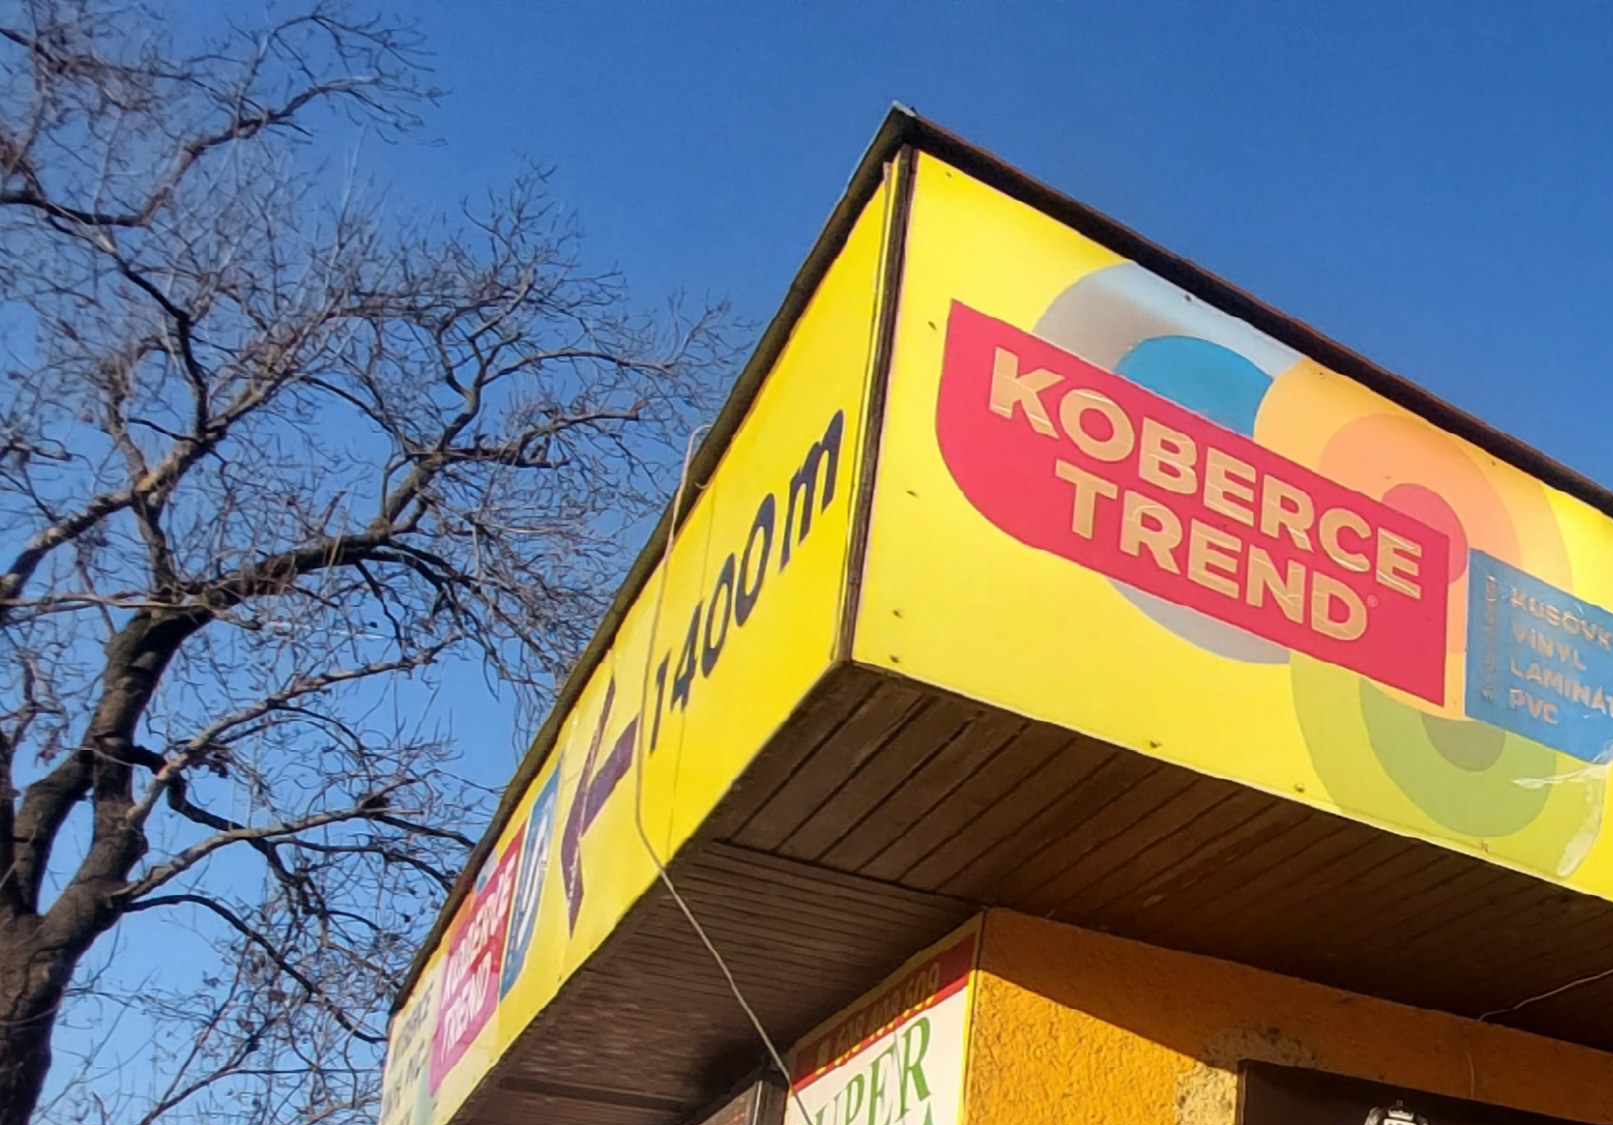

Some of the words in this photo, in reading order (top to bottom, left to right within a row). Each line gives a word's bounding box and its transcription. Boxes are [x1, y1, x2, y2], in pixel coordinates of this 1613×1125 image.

[988, 346, 1423, 600] KOBERCE
[1054, 460, 1368, 642] TREND
[1511, 622, 1587, 671] VINYL
[1509, 687, 1559, 725] PVC
